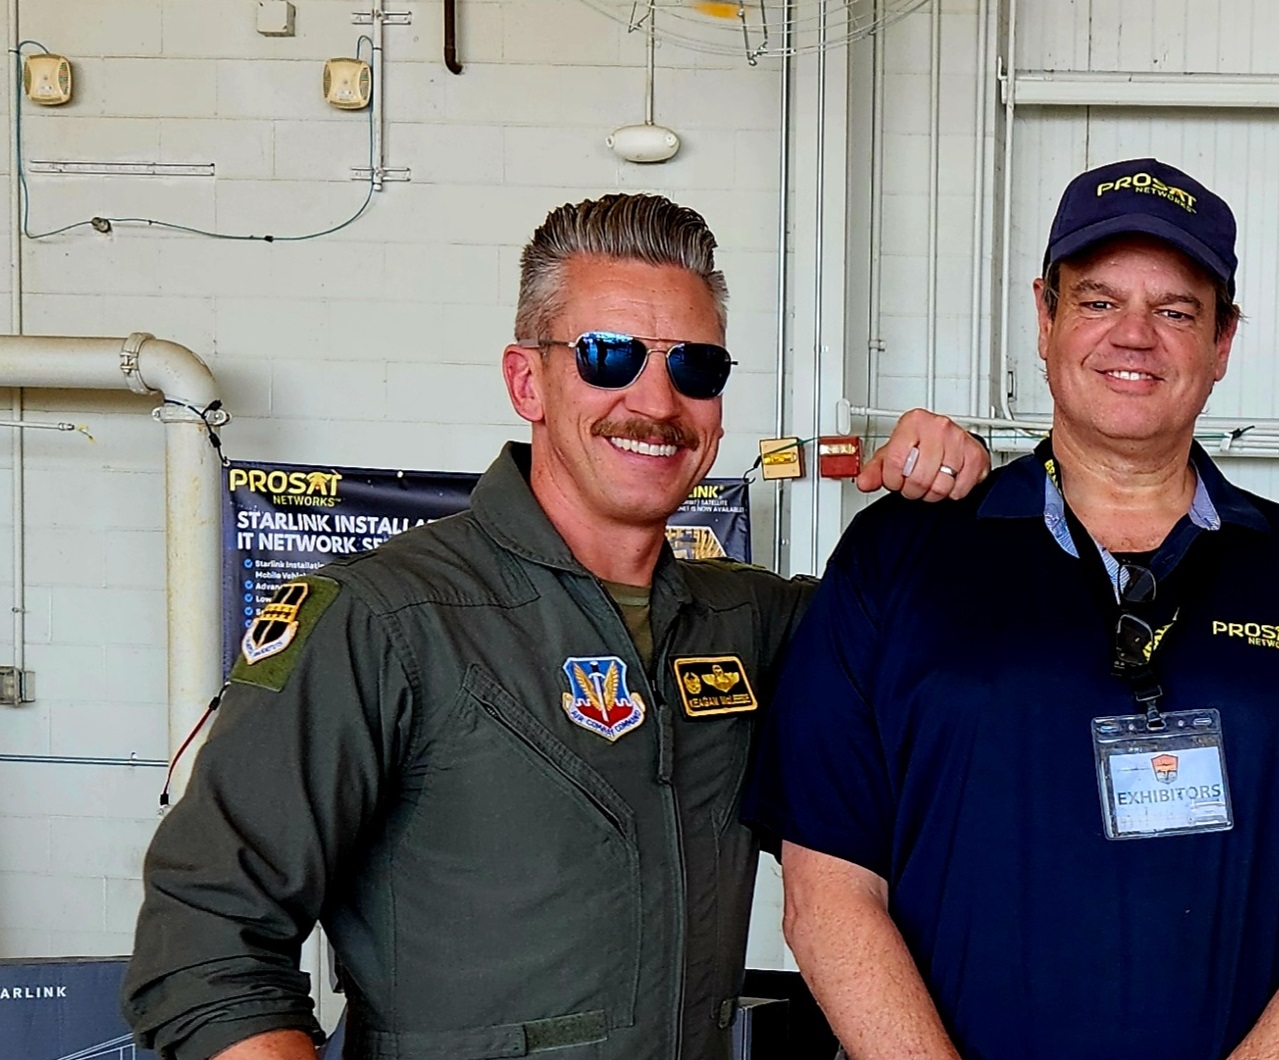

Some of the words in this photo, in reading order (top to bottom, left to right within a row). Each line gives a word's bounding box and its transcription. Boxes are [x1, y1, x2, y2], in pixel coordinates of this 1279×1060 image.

[1097, 173, 1197, 207] PROSAT
[229, 469, 343, 496] PROSAT
[688, 485, 719, 498] INK
[237, 511, 332, 532] STARLINK
[335, 515, 438, 535] INSTALL
[237, 532, 255, 550] IT
[259, 534, 357, 554] NETWORK
[255, 560, 285, 568] Starlink
[255, 571, 282, 579] Mobile
[1117, 783, 1222, 807] EXHIBITORS
[0, 986, 68, 999] ARLINK
